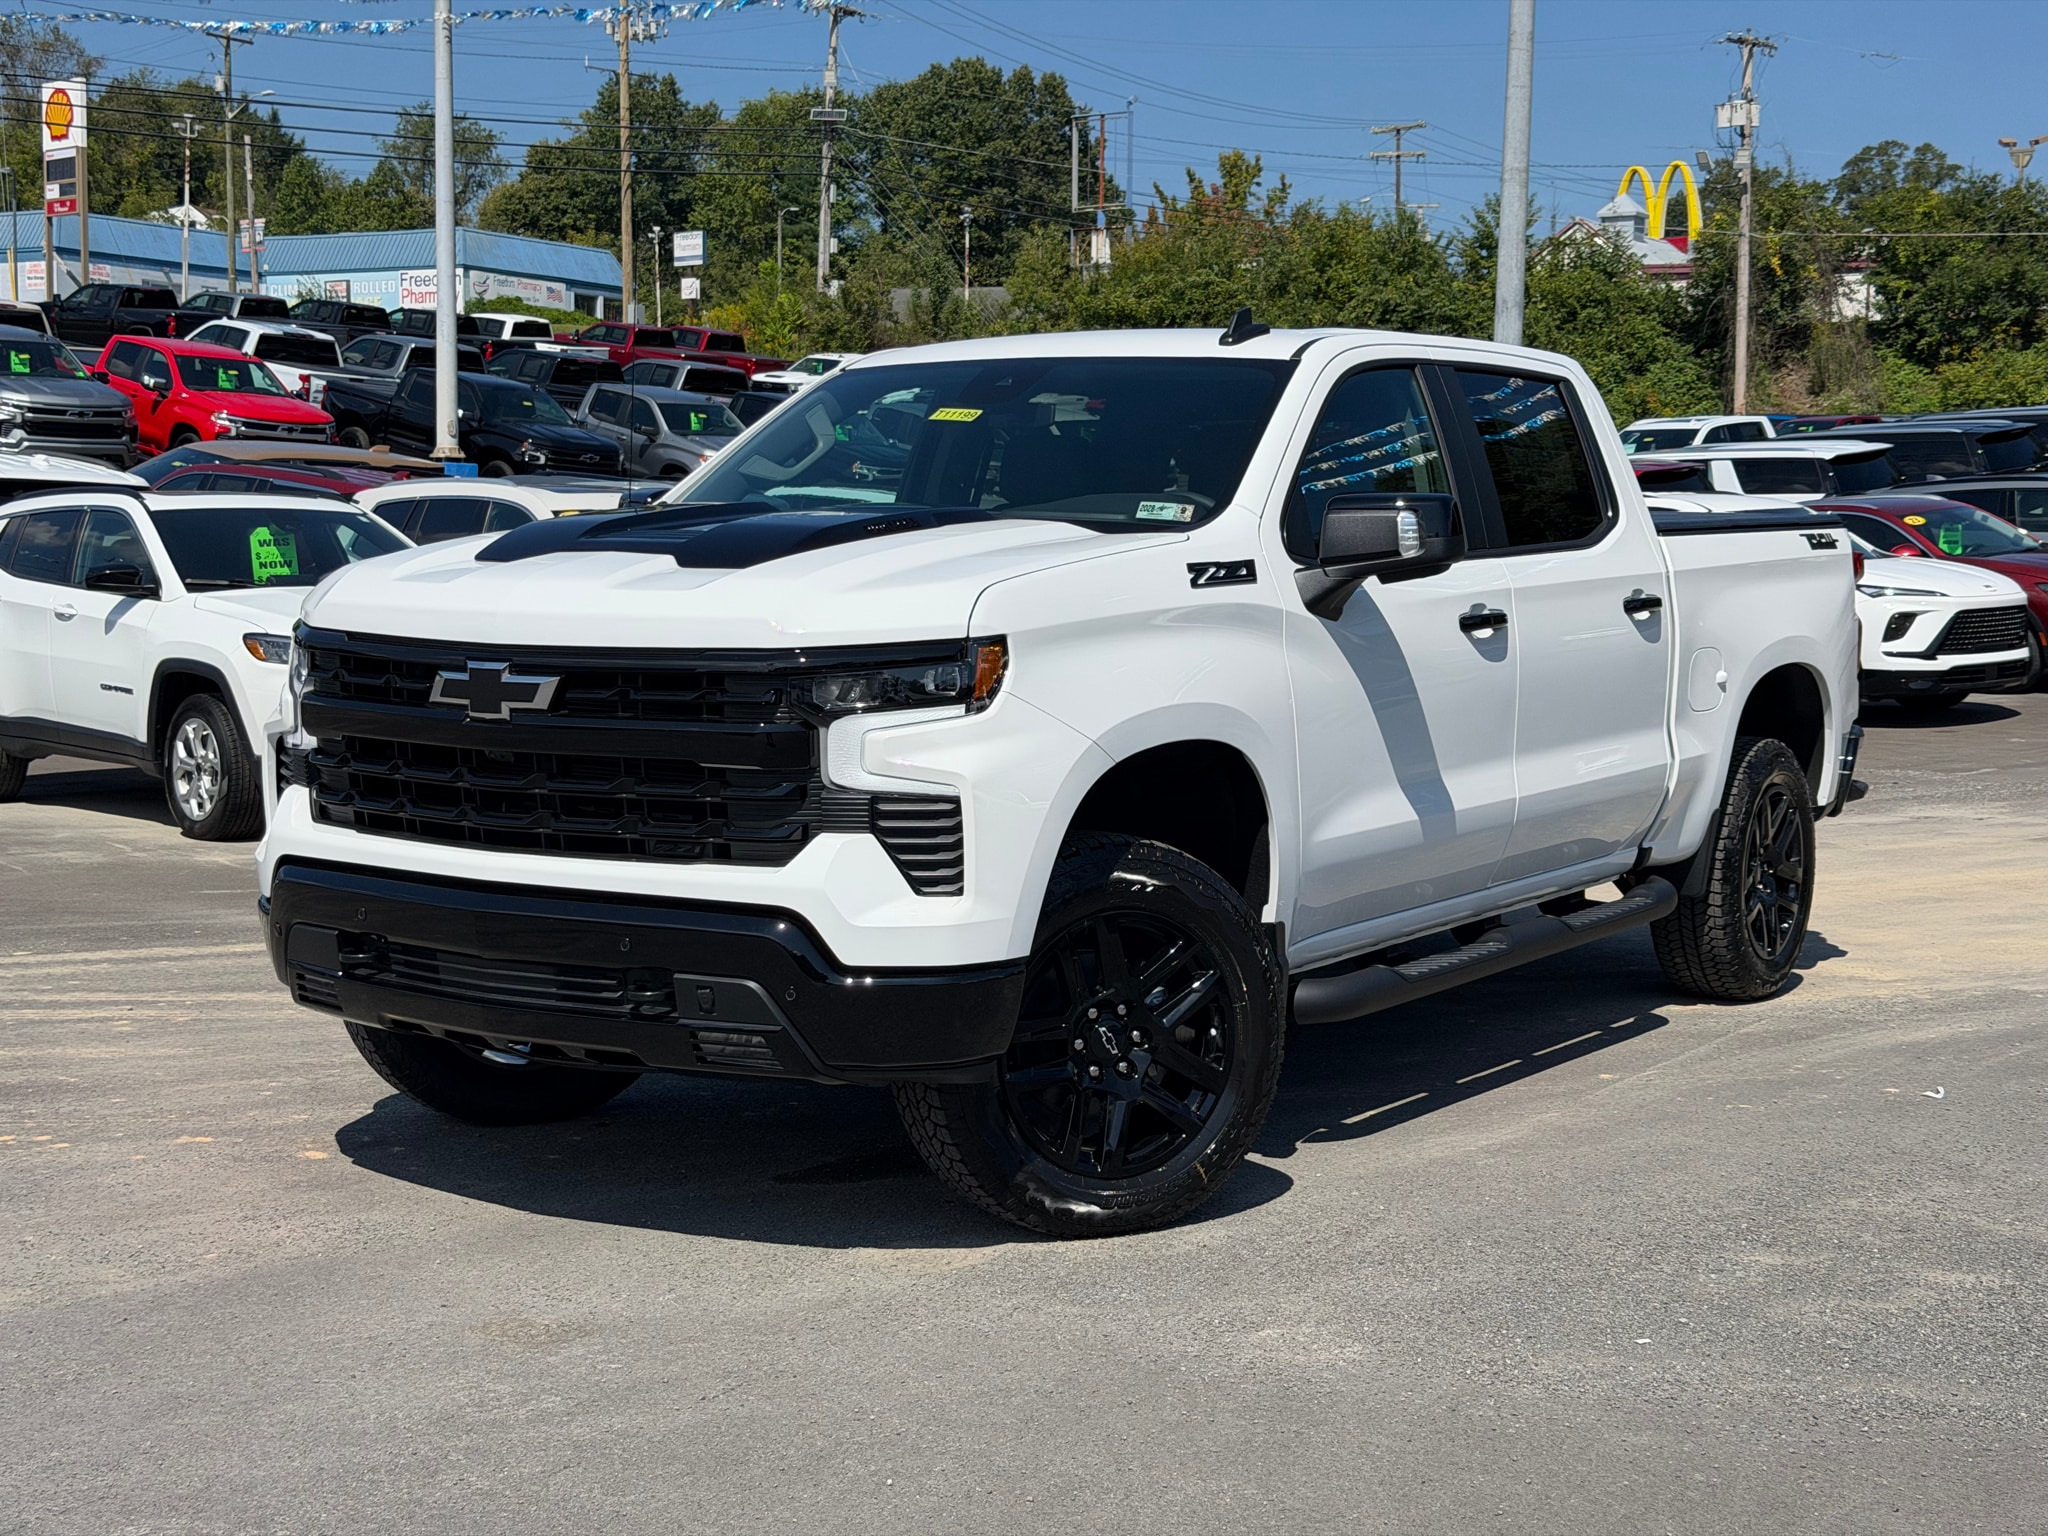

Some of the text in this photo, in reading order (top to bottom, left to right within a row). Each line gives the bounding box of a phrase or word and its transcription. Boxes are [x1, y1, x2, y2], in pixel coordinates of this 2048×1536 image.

[353, 280, 396, 294] ROLLED
[935, 409, 978, 419] T11199
[257, 537, 290, 548] WAS
[258, 560, 293, 569] NOW
